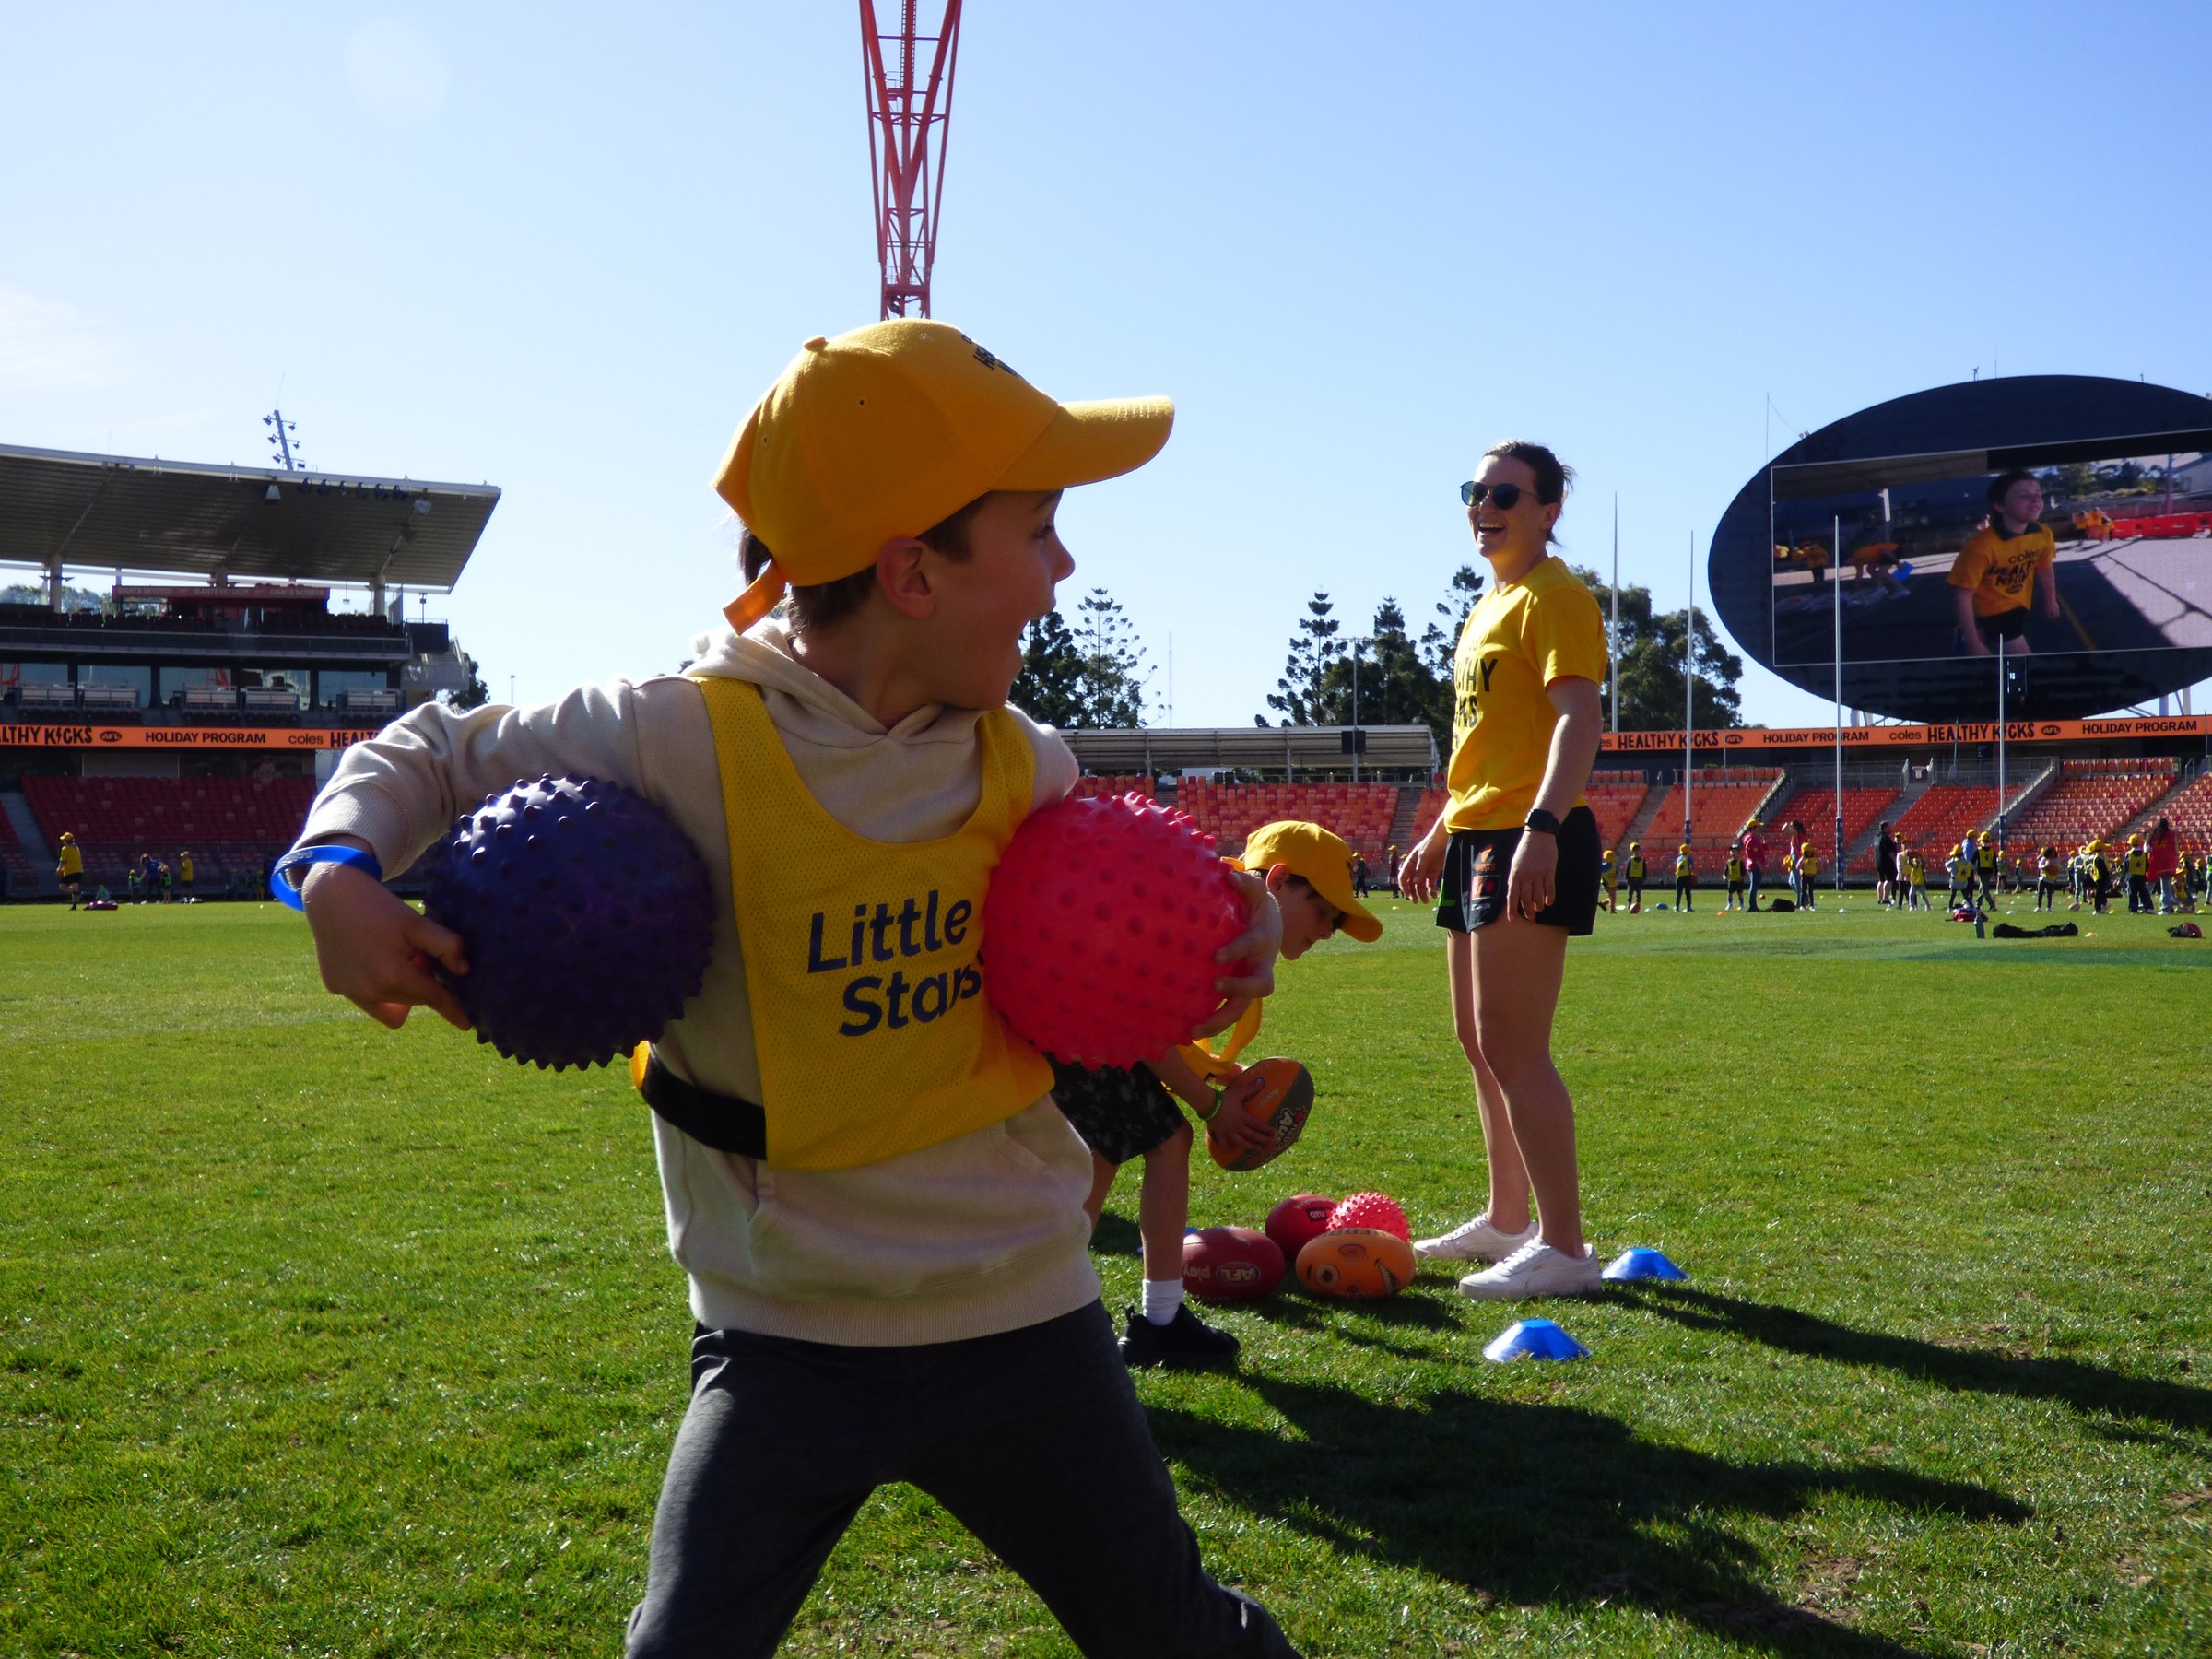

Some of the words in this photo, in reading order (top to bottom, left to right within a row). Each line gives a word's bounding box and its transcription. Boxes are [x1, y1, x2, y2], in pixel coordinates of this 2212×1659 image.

[0, 726, 41, 744] LTHY
[145, 732, 199, 743] HOLIDAY
[202, 733, 266, 743] PROGRAM
[288, 733, 324, 745] coles
[1618, 733, 1676, 749] HEALTHY
[1678, 732, 1719, 748] KCKS
[1763, 733, 1809, 743] HOLIDAY
[1889, 729, 1923, 741] coles
[1927, 724, 1989, 743] HEALTHY
[2082, 723, 2133, 735] HOLIDAY
[2135, 721, 2197, 733] PROGRAM
[807, 889, 972, 973] Little
[1221, 1267, 1254, 1281] AFL
